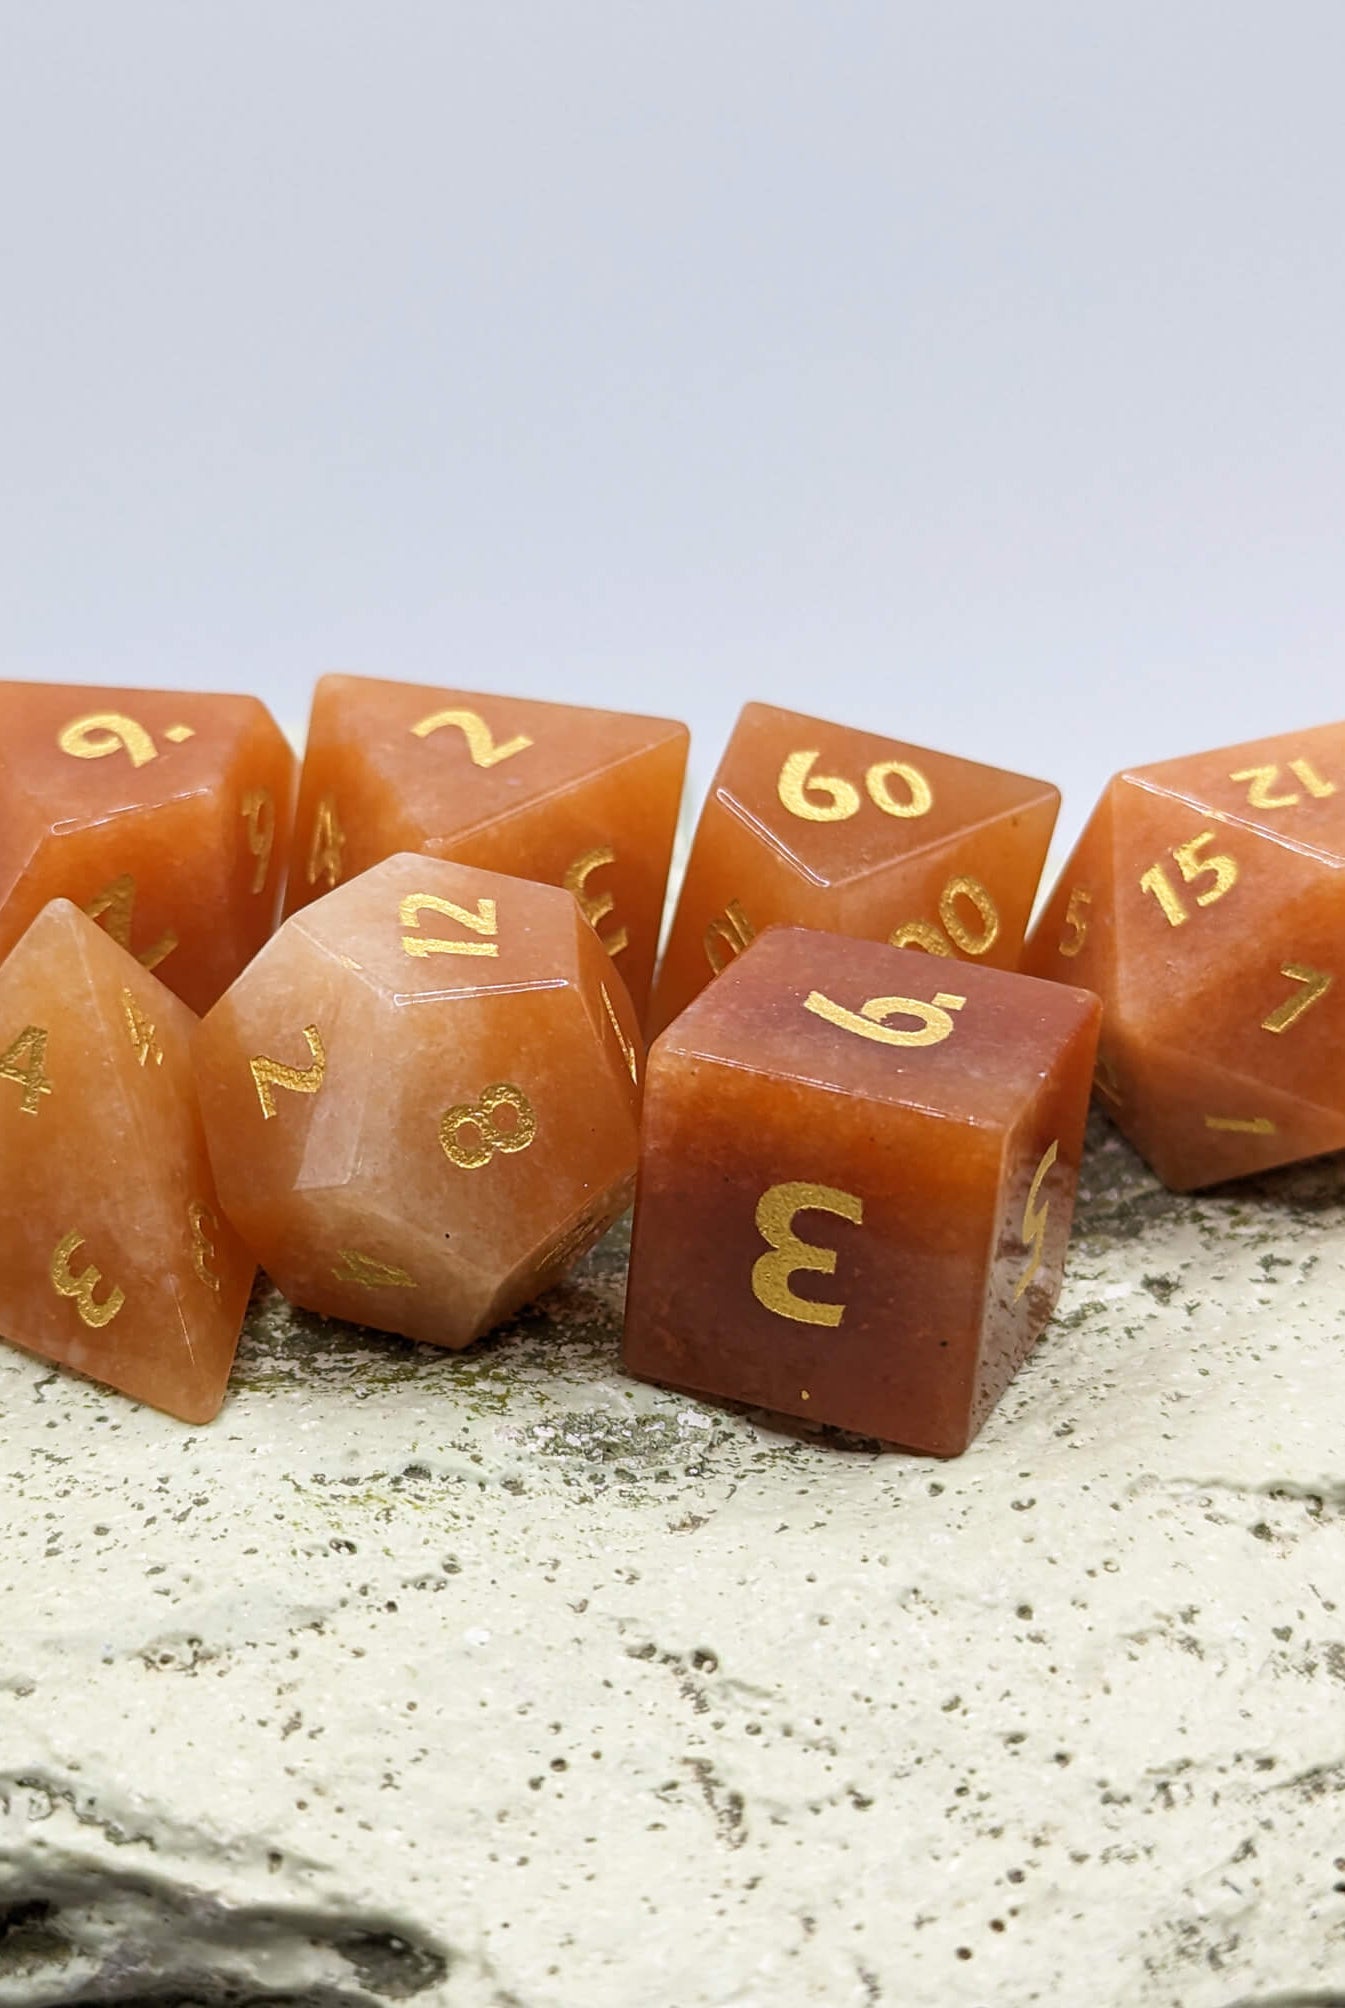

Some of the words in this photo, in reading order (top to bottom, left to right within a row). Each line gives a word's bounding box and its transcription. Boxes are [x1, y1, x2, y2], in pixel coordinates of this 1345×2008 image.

[410, 709, 534, 768] 2
[777, 749, 933, 822] 60
[1229, 759, 1336, 809] 12
[1139, 831, 1238, 927] 15
[399, 893, 500, 958] 12
[1059, 887, 1092, 957] 5
[1260, 962, 1333, 1034] 7
[0, 1025, 52, 1114] 4
[439, 1082, 537, 1169] 8
[50, 1230, 126, 1329] 3
[188, 1202, 220, 1291] 3
[752, 1181, 863, 1328] 3
